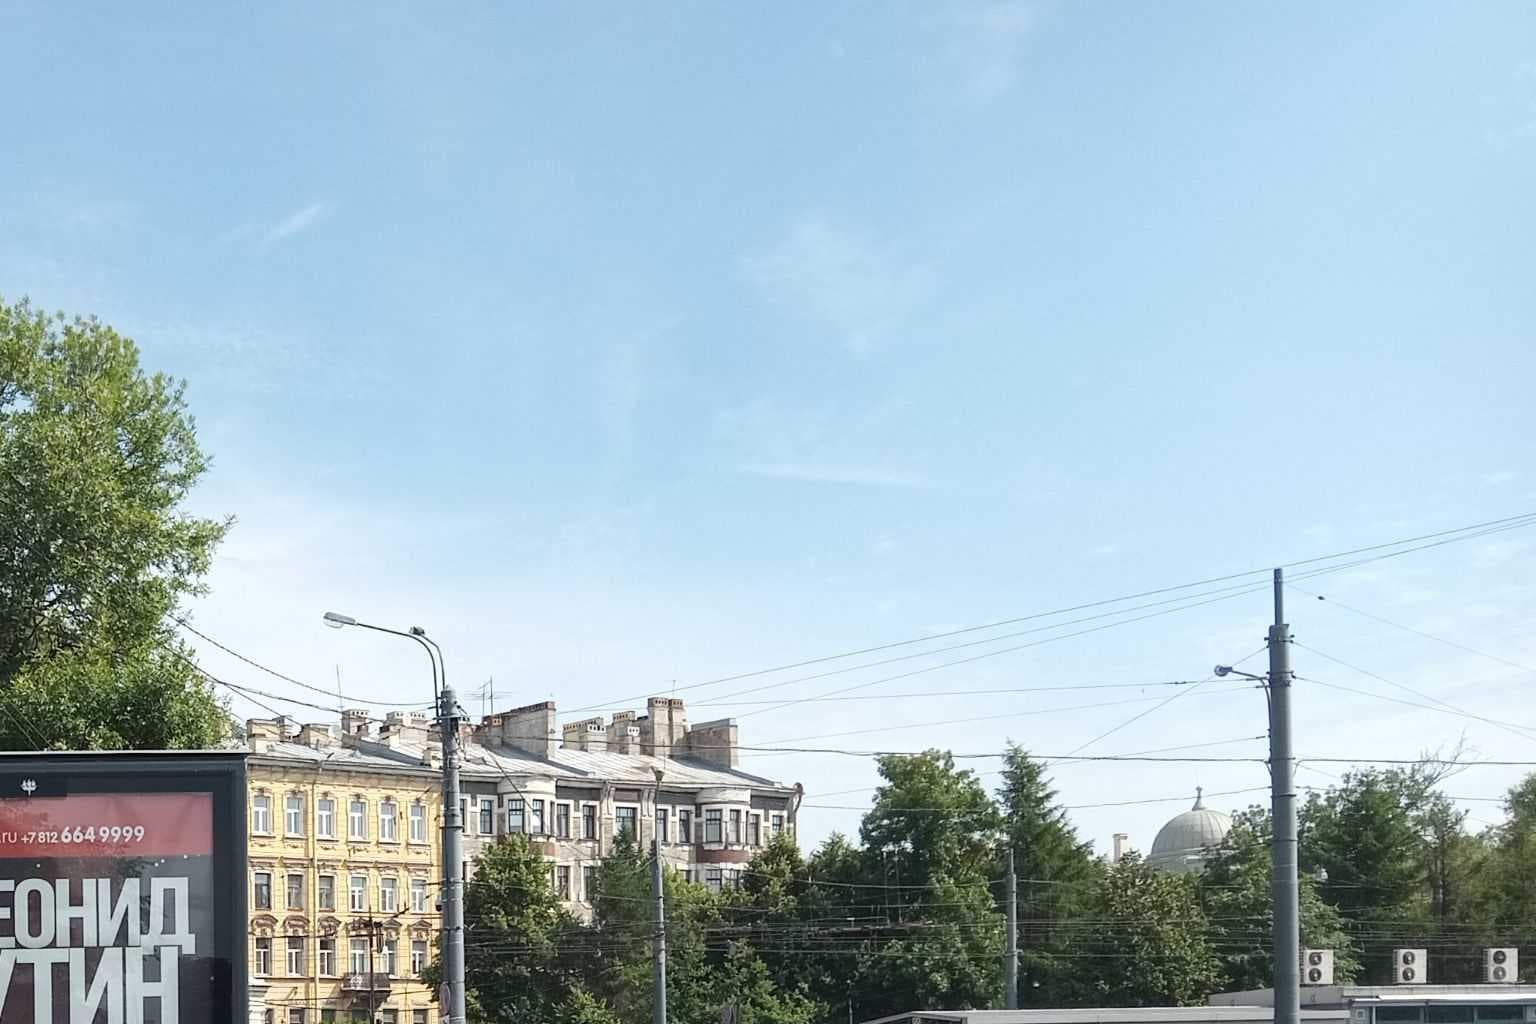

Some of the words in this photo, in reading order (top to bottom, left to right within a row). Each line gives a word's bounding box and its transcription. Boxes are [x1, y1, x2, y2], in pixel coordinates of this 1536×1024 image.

[20, 832, 36, 844] +7
[38, 831, 58, 844] 812
[61, 826, 96, 844] 664
[99, 825, 145, 843] 9999
